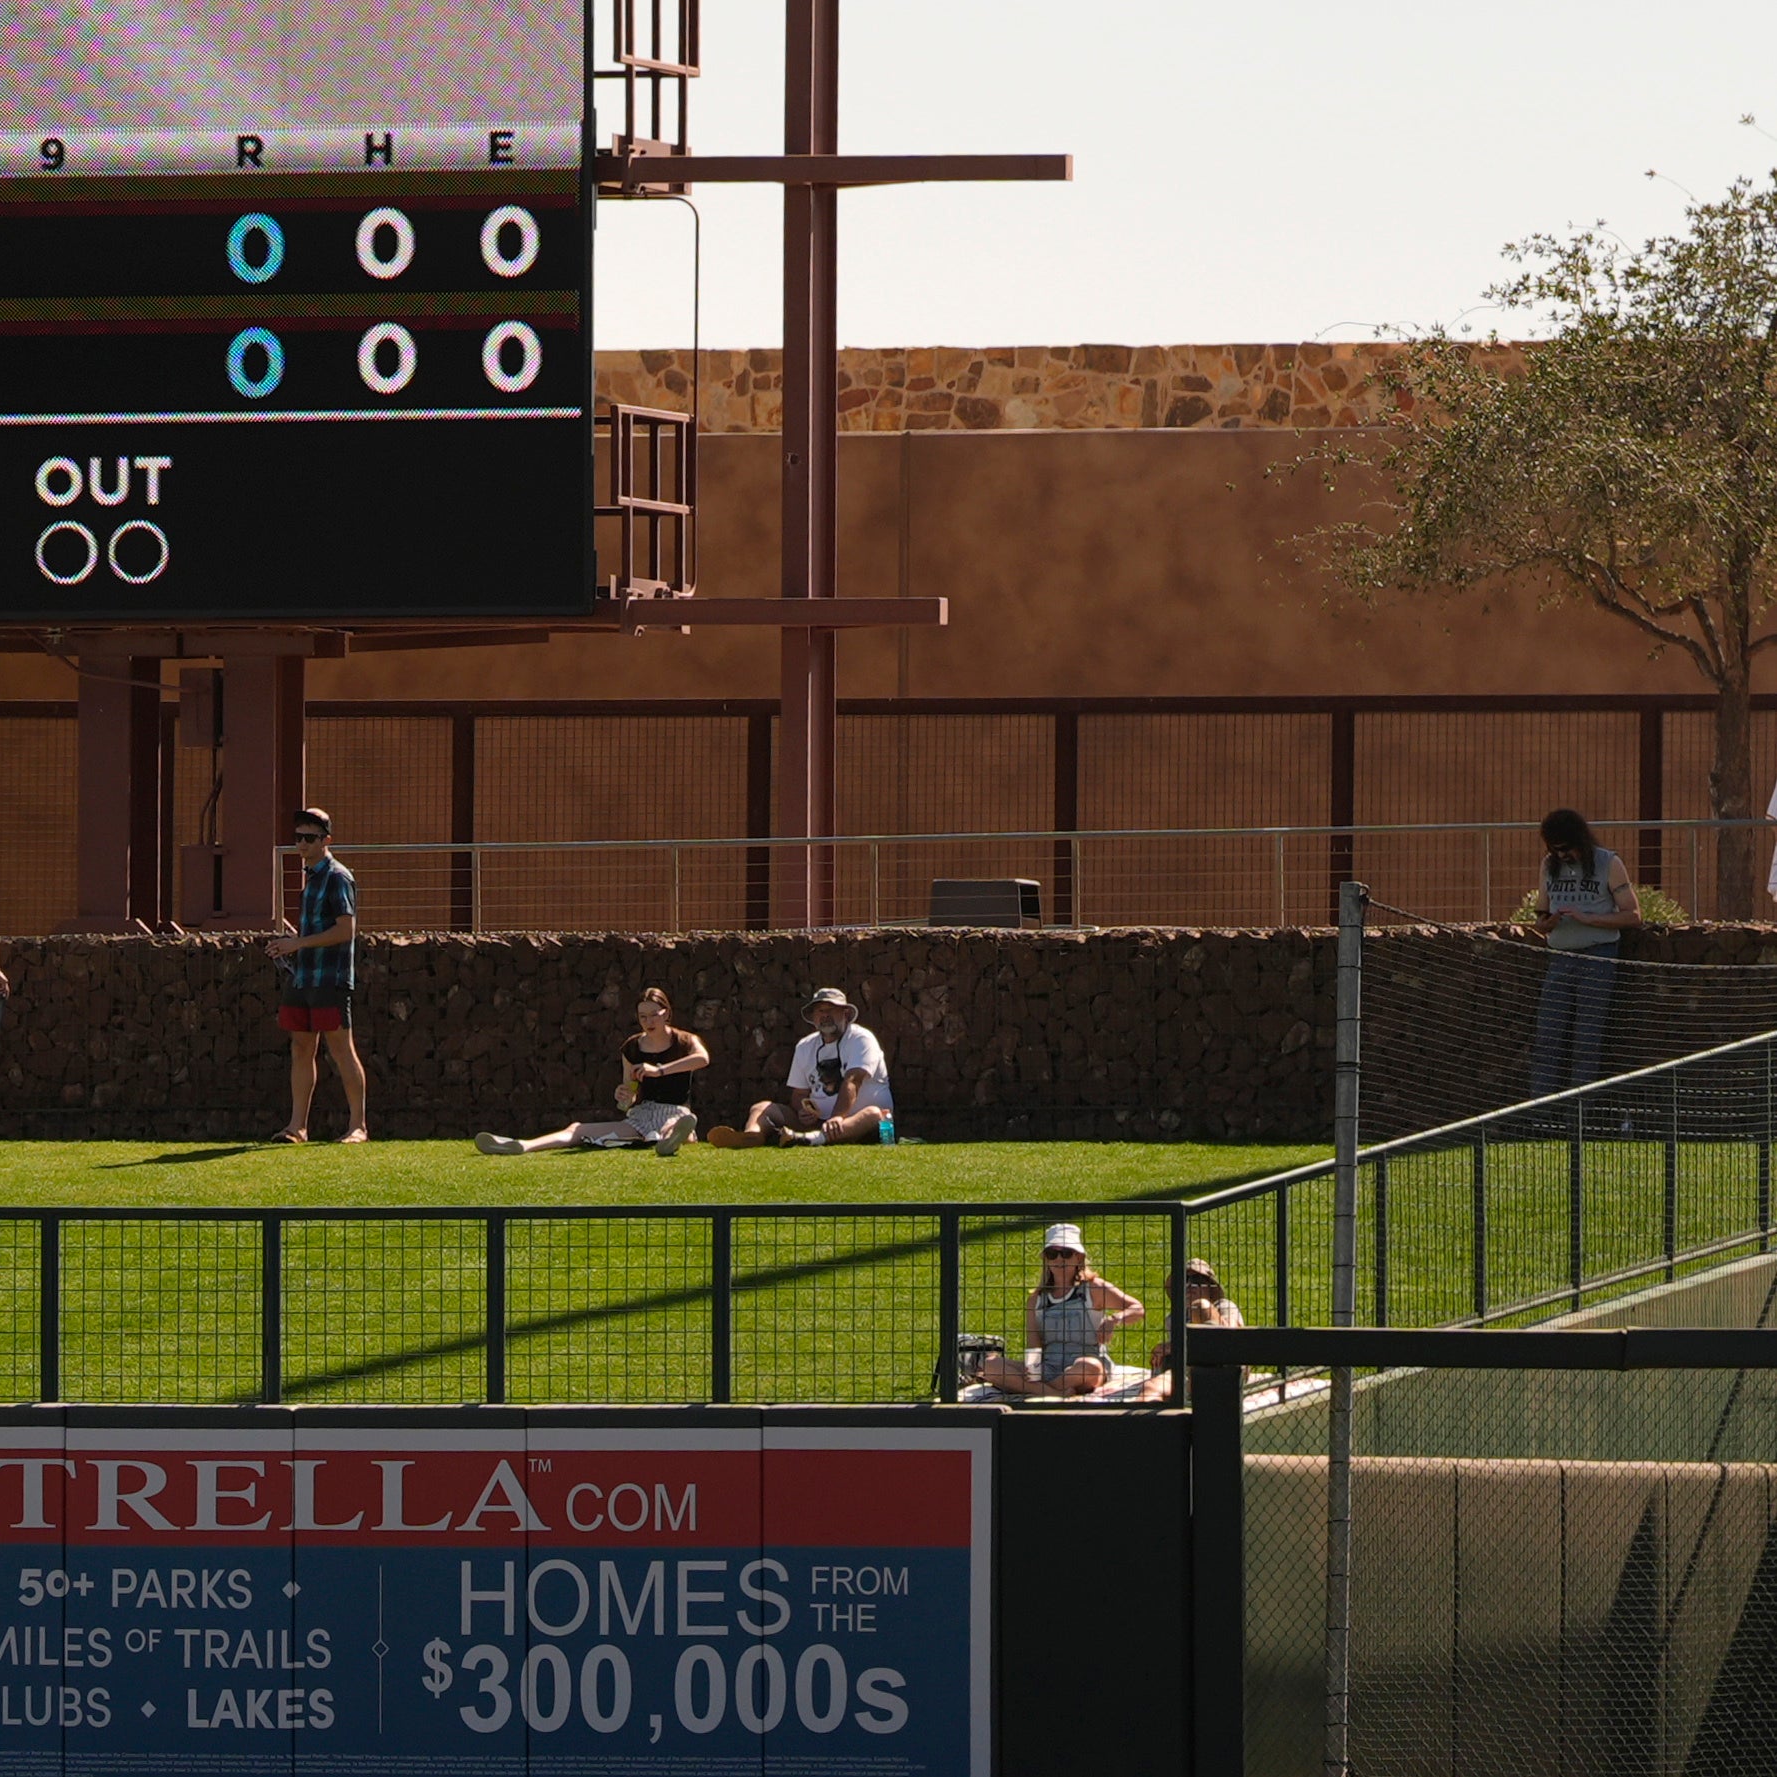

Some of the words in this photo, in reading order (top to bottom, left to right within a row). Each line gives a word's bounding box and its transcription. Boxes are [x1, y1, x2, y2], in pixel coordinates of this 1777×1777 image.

[40, 138, 65, 173] 9
[237, 135, 264, 170] R
[363, 133, 393, 167] H
[488, 131, 513, 165] E
[225, 212, 286, 284] 0
[355, 206, 416, 280] 0
[479, 205, 541, 278] 0
[225, 327, 286, 400] 0
[356, 322, 418, 395] 0
[481, 320, 543, 393] 0
[34, 455, 174, 507] OUT
[1579, 879, 1601, 895] SOX
[565, 1482, 697, 1532] COM
[18, 1568, 95, 1607] 50+
[111, 1568, 252, 1610] PARKS
[460, 1558, 791, 1637] HOMES
[810, 1566, 909, 1595] FROM
[810, 1604, 877, 1632] THE
[125, 1628, 162, 1653] OF
[175, 1628, 332, 1669] TRAILS
[187, 1688, 335, 1729] LAKES
[421, 1636, 910, 1744] $300,000s
